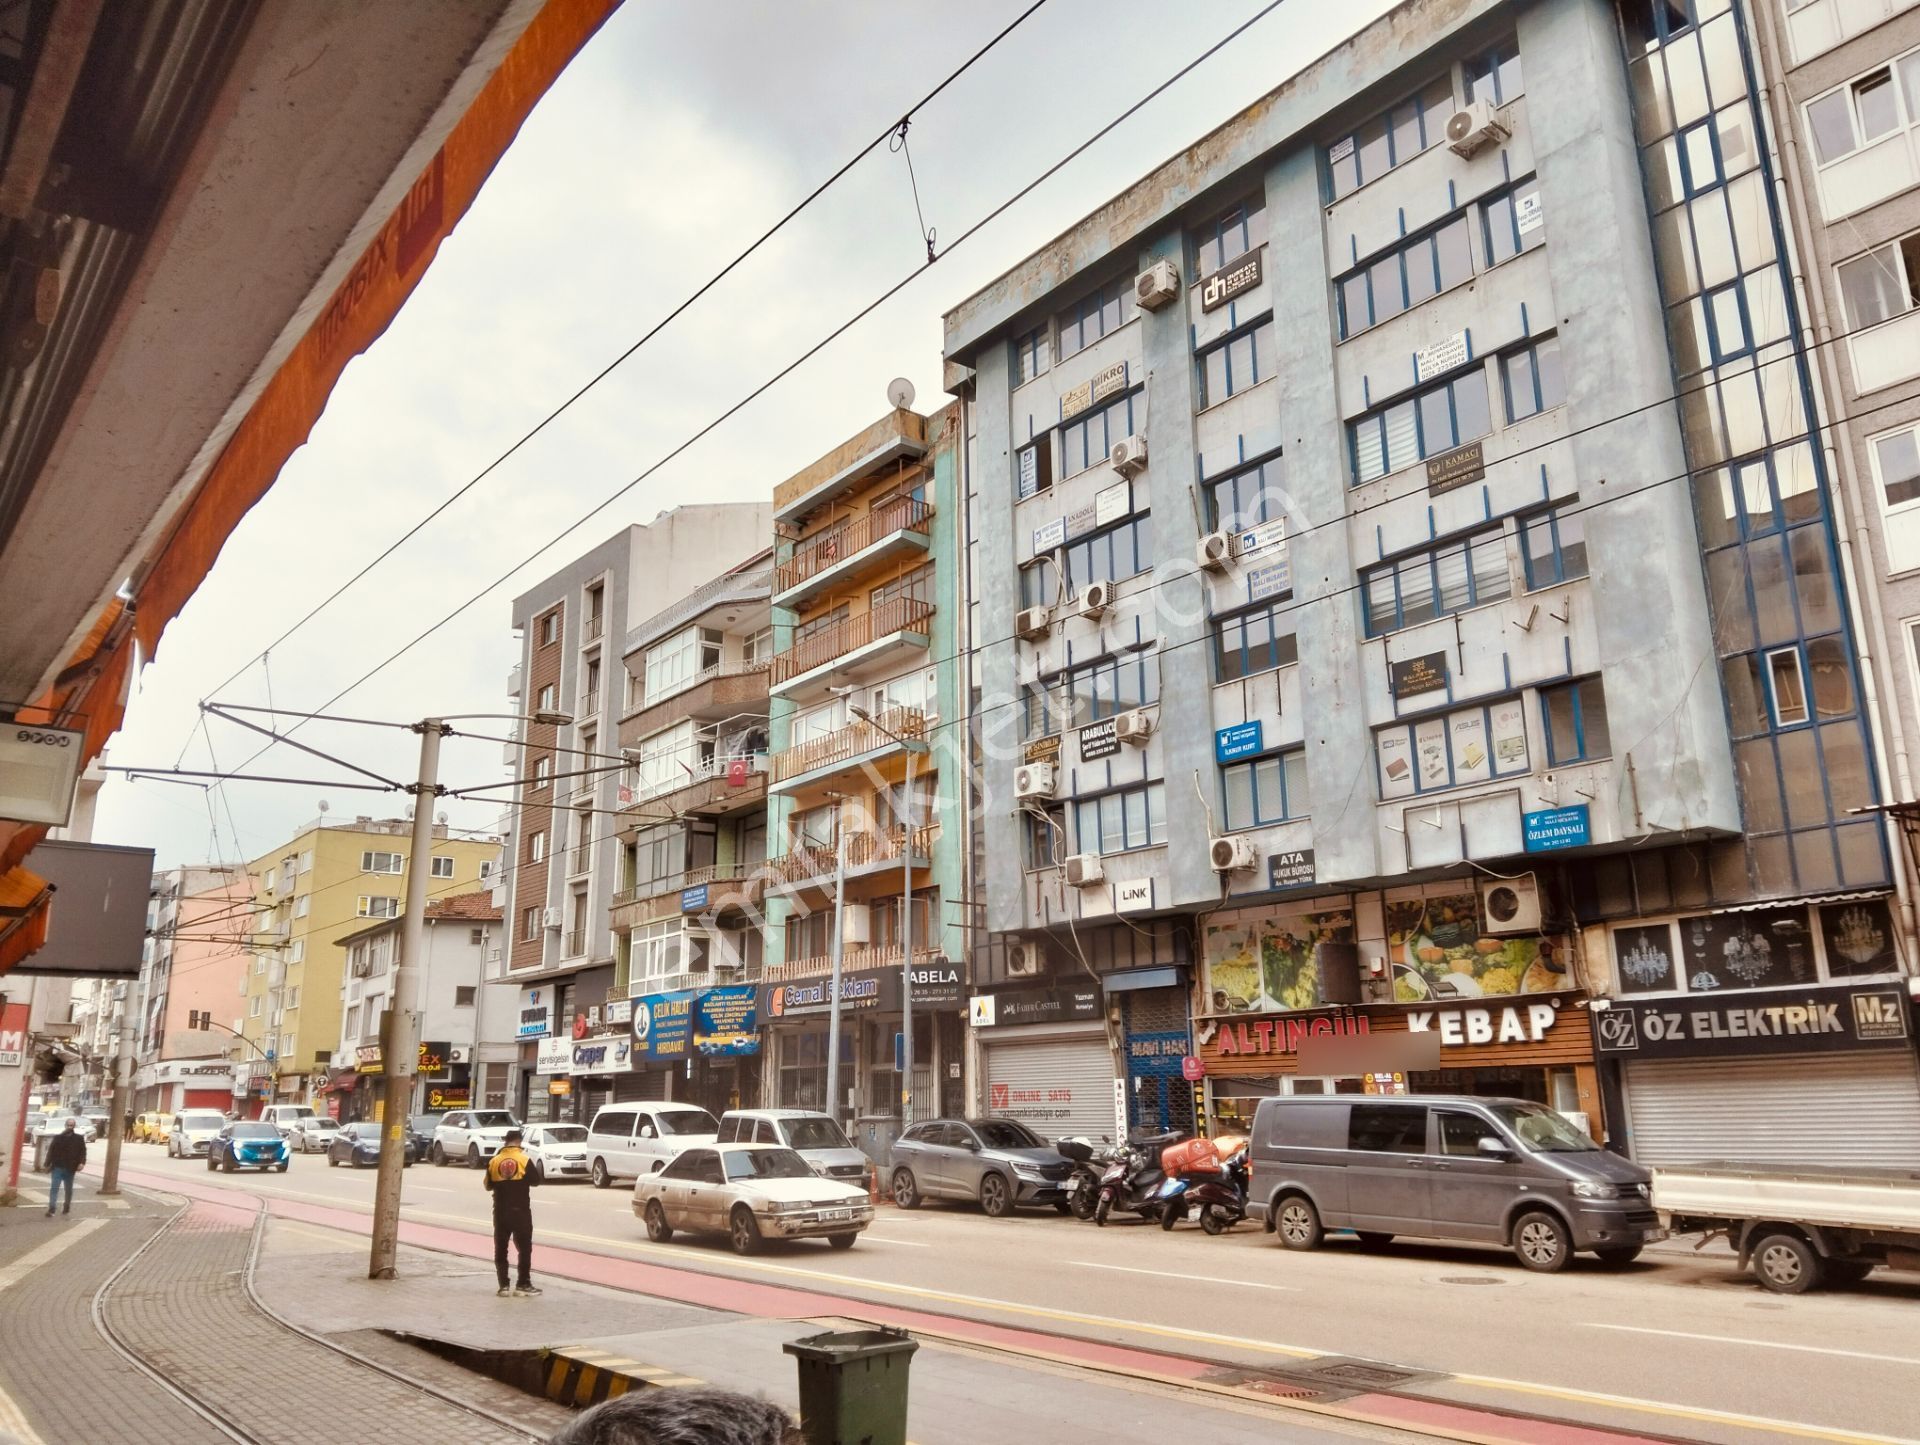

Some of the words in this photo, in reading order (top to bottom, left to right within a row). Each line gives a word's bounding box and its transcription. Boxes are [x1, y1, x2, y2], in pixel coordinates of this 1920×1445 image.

[1528, 828, 1553, 840] ÖZLEM
[1280, 852, 1304, 866] ATA
[1273, 867, 1291, 879] HUKUK
[1291, 863, 1314, 877] BÜROSU
[899, 969, 959, 985] TABELA
[784, 981, 825, 1007] Cemal
[1643, 1009, 1686, 1041] ÖZ
[1691, 1000, 1845, 1040] ELEKTRİK
[1855, 996, 1900, 1024] Mz
[1406, 1003, 1557, 1046] KEBAP
